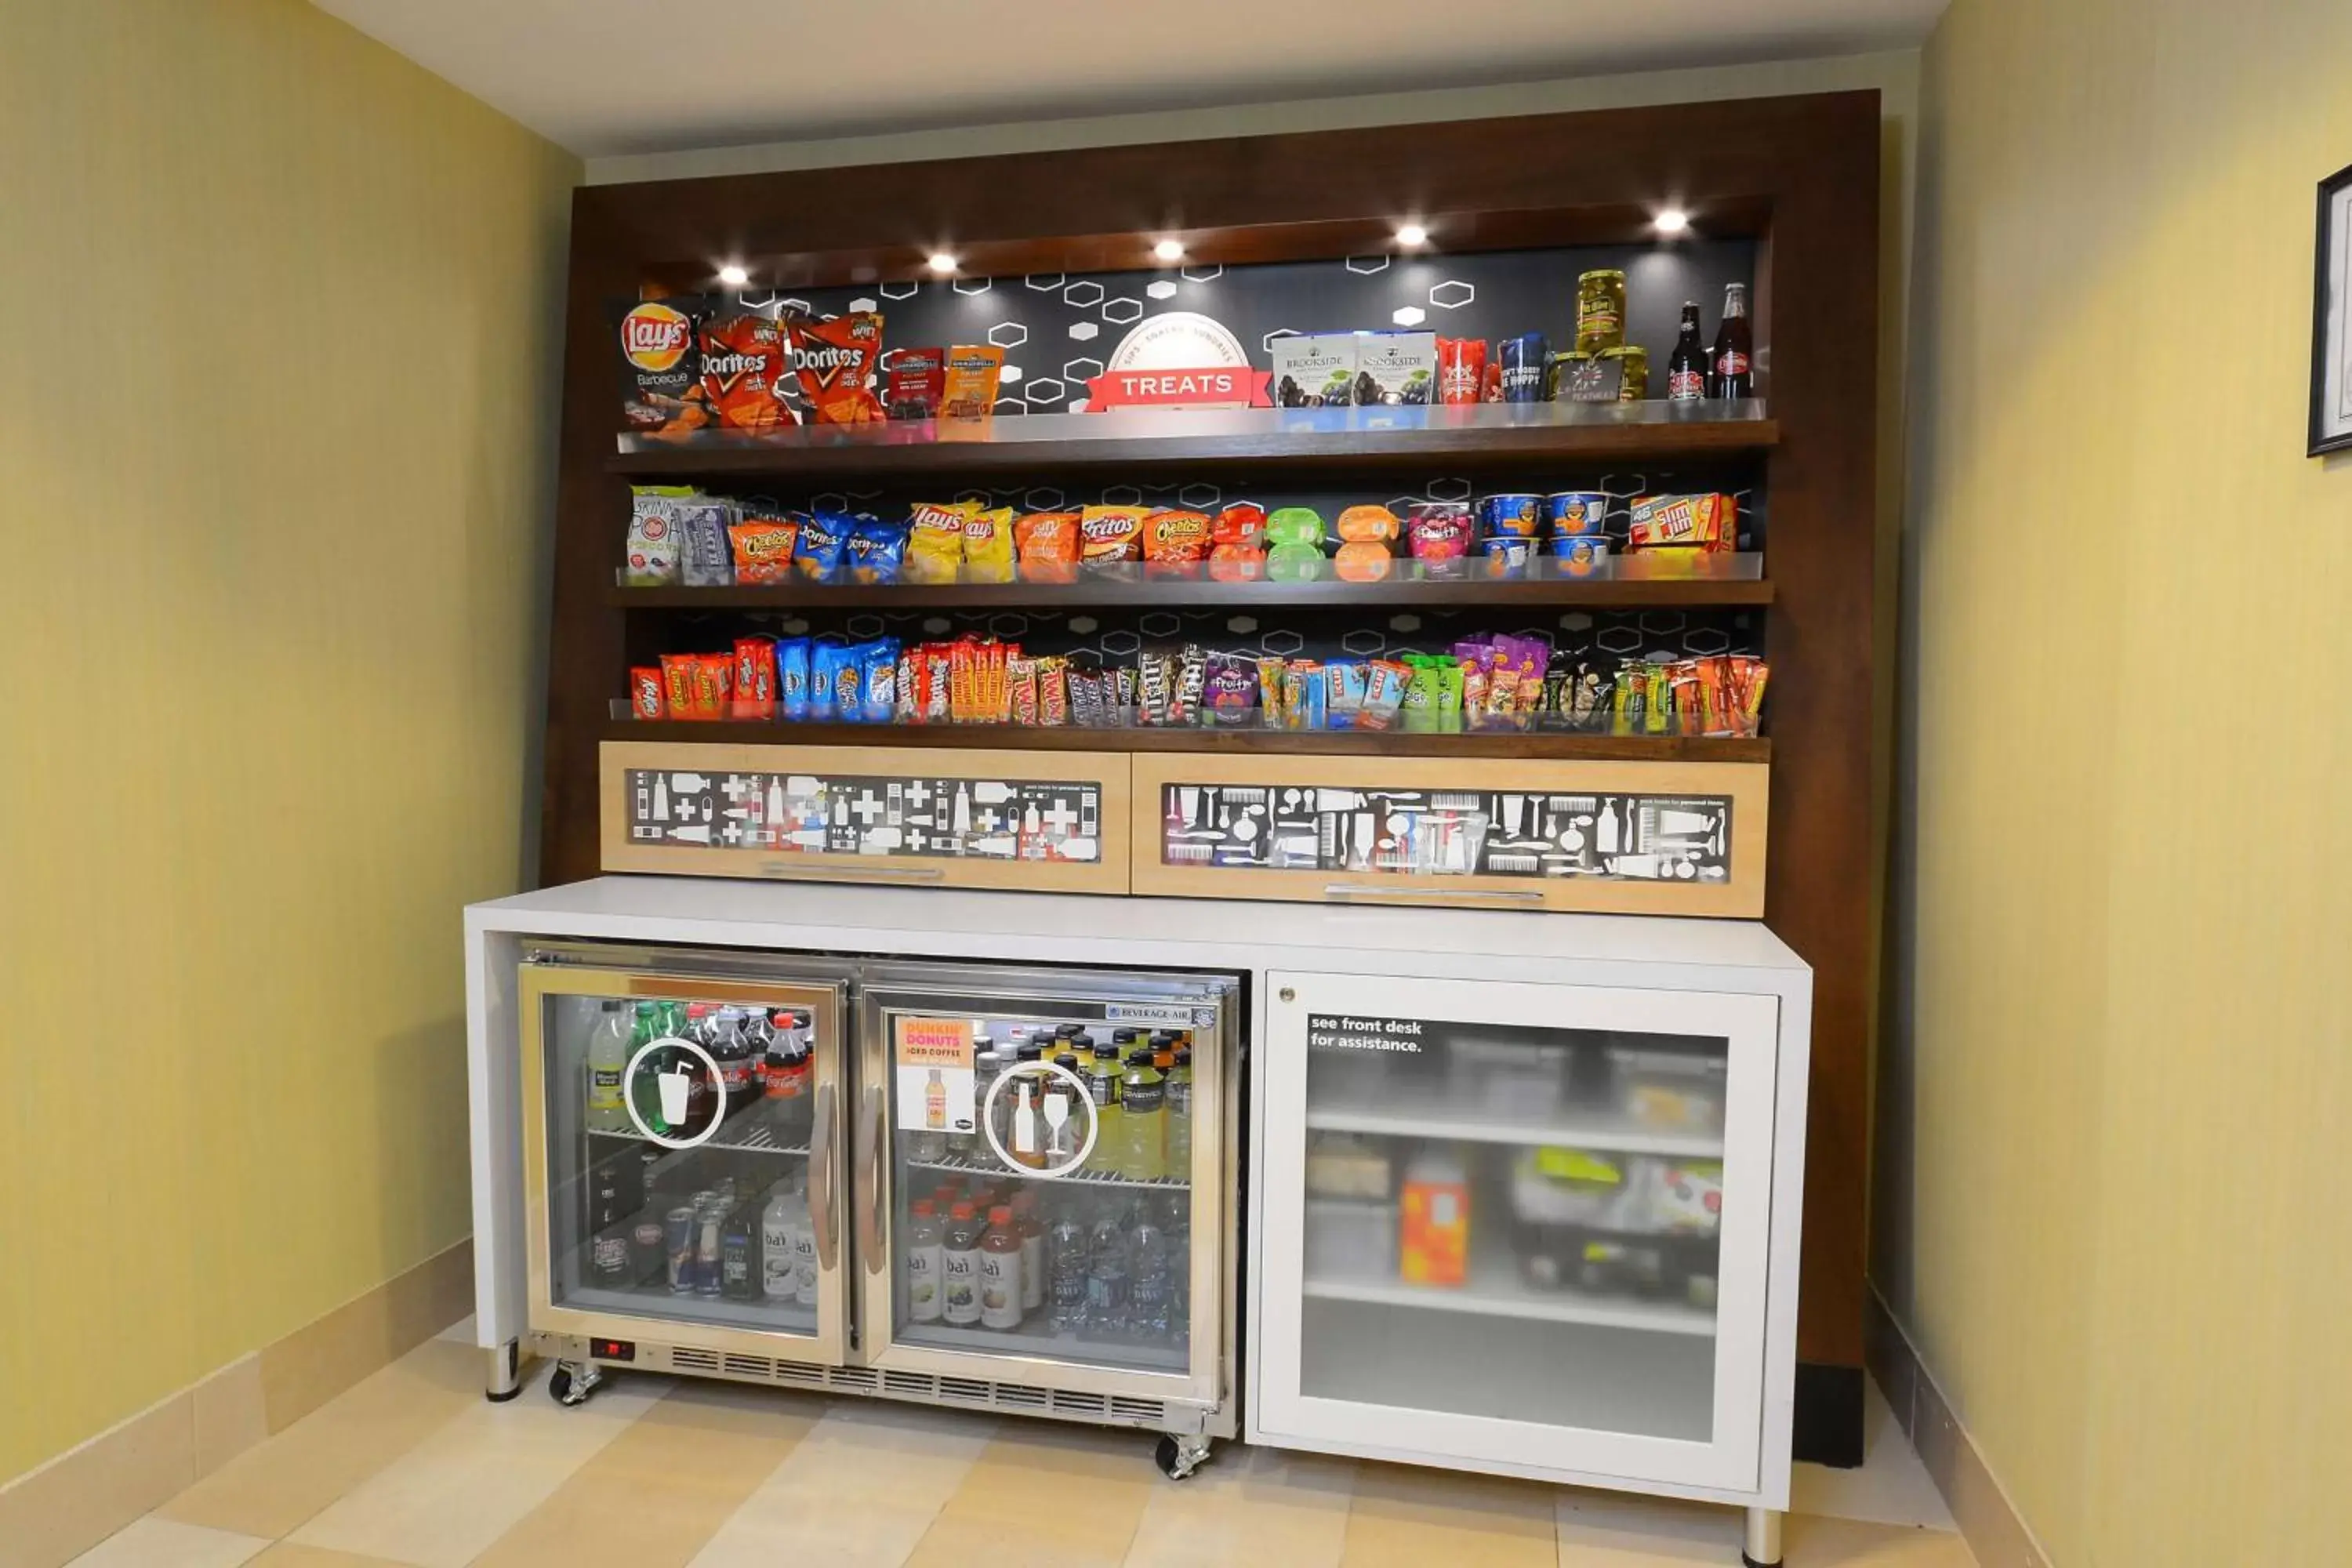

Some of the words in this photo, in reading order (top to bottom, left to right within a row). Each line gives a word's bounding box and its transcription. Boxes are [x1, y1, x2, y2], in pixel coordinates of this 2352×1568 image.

[630, 318, 686, 352] Lay's
[700, 354, 766, 374] Doritos
[793, 347, 863, 370] Doritos
[637, 372, 688, 386] Barbecue
[1120, 375, 1232, 396] TREATS
[916, 507, 962, 532] Lay's
[1084, 517, 1134, 538] Fritos
[1156, 517, 1204, 543] Cheetos
[1312, 1018, 1338, 1029] see
[1341, 1017, 1382, 1033] front
[1385, 1020, 1422, 1035] desk
[906, 1035, 960, 1047] DONUTS
[1311, 1032, 1335, 1047] for
[1338, 1036, 1422, 1053] assistance.
[929, 1048, 961, 1058] COFFEE
